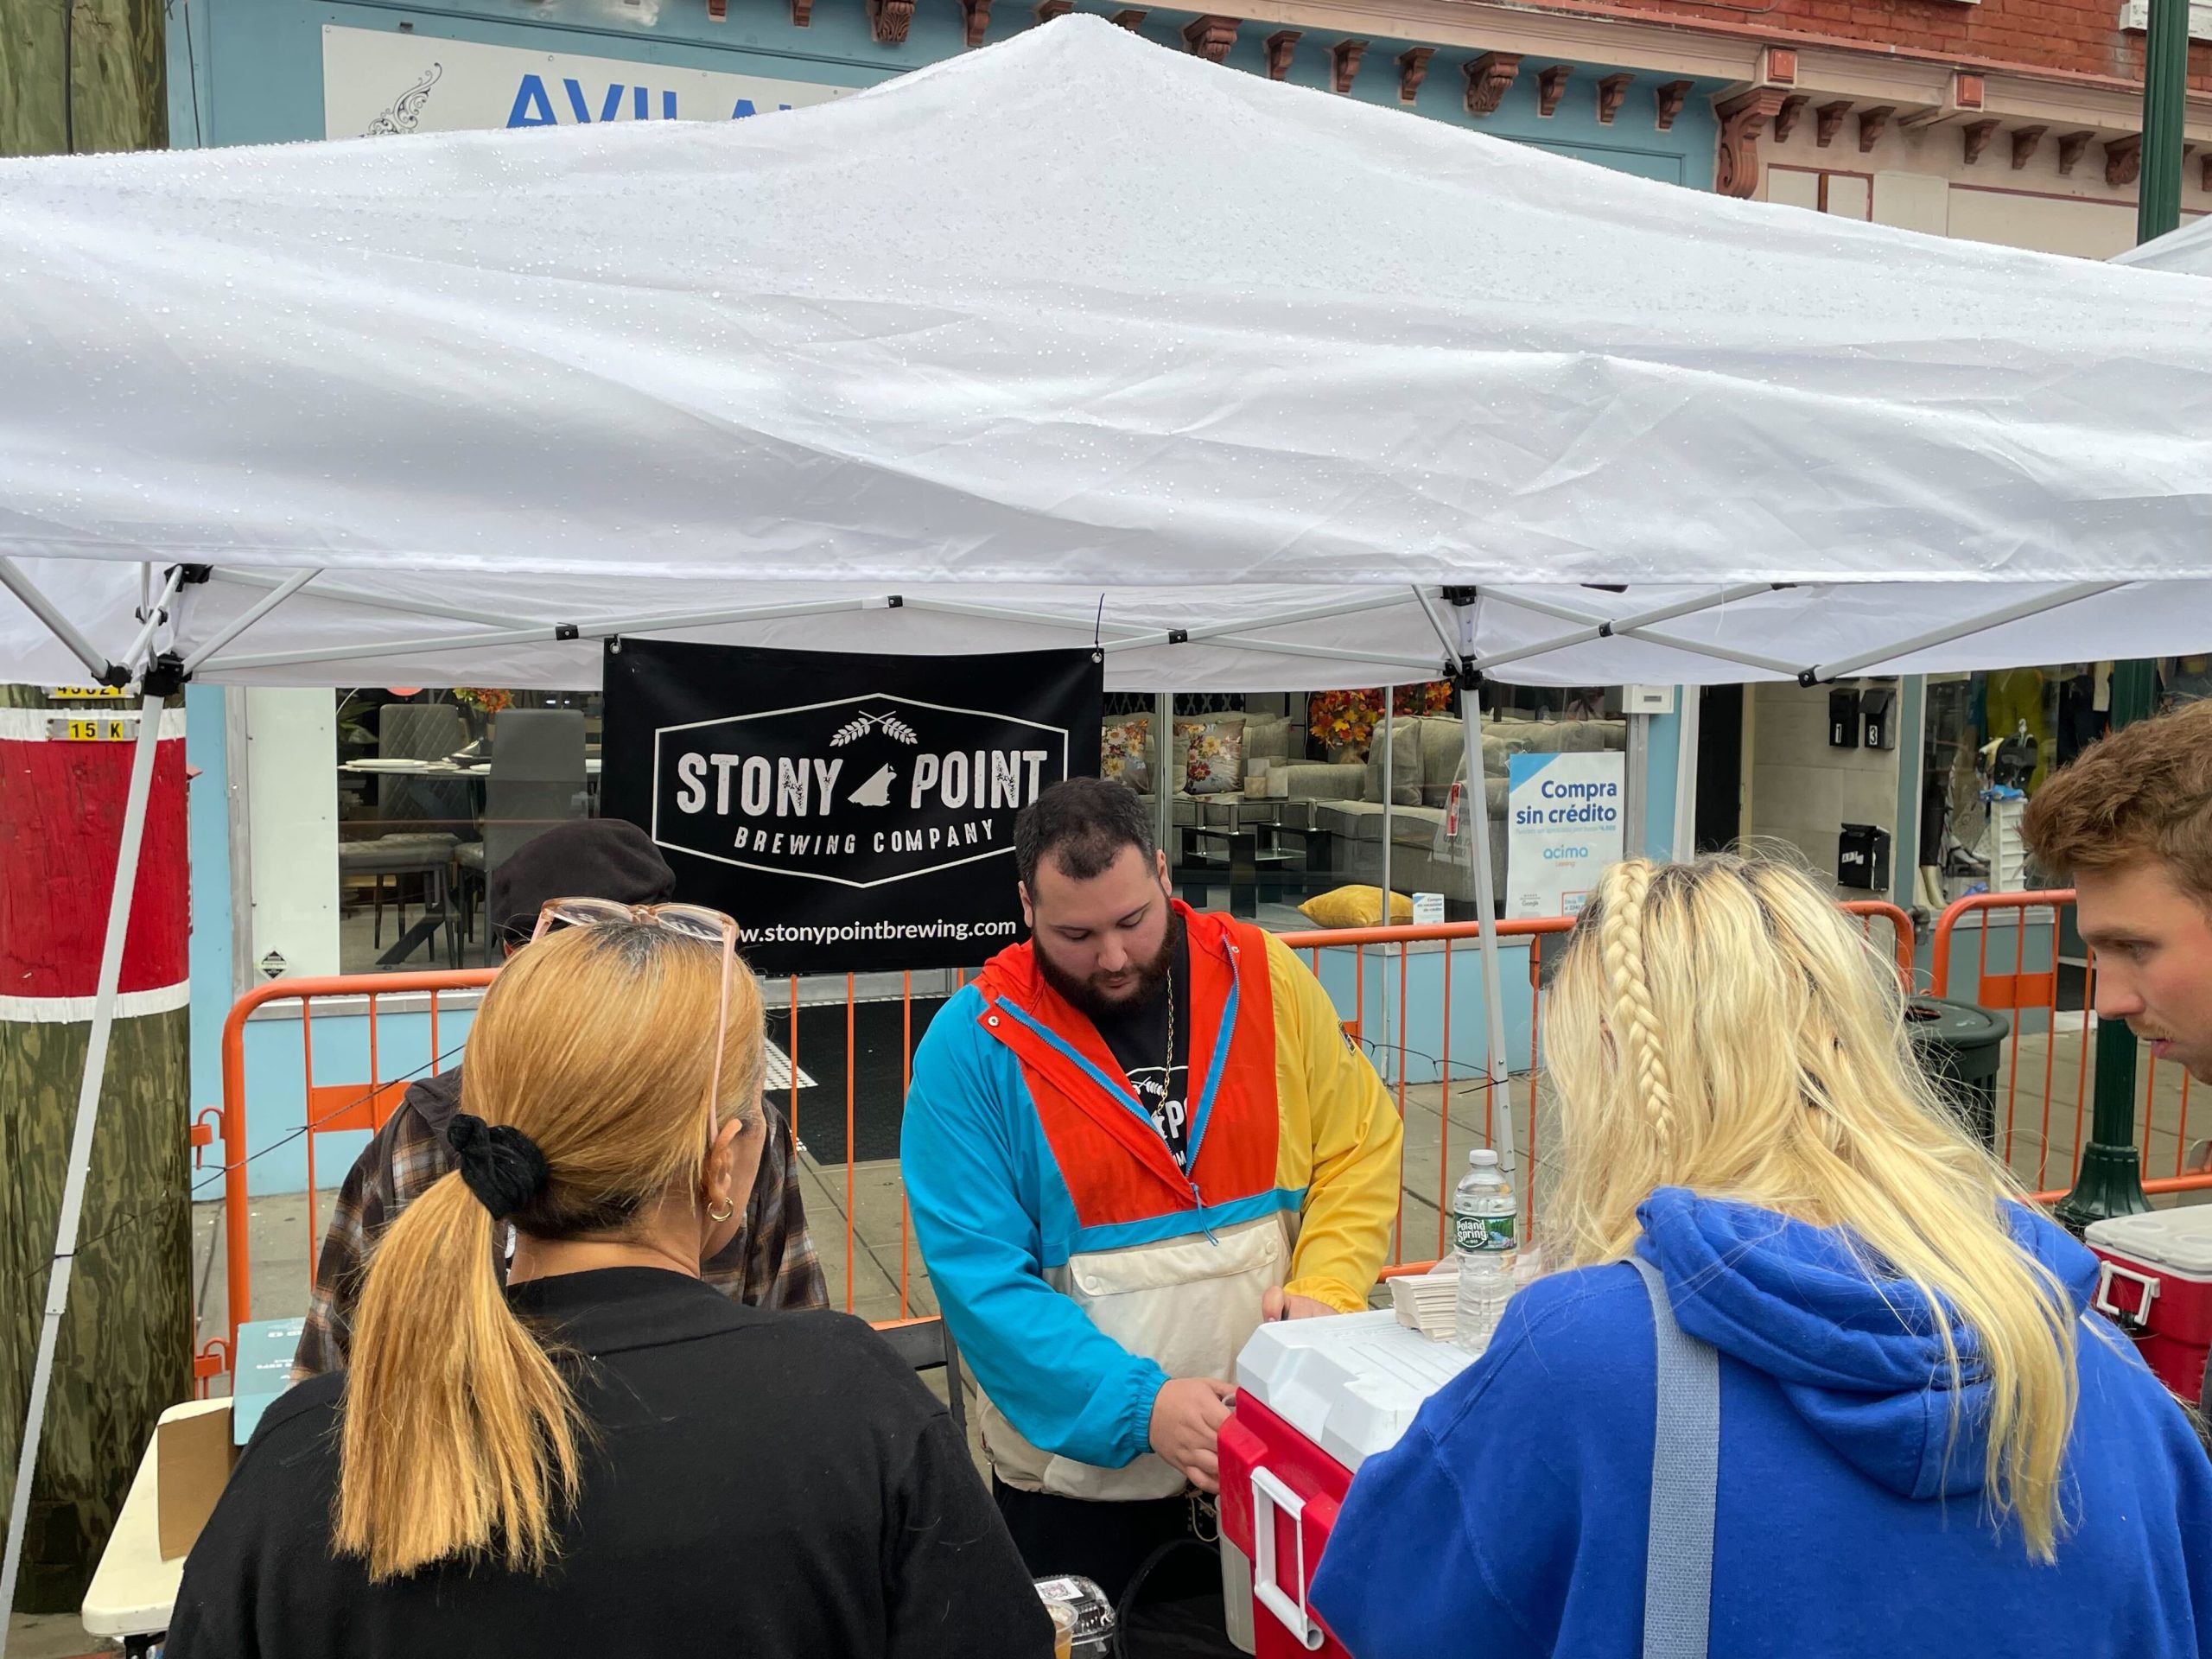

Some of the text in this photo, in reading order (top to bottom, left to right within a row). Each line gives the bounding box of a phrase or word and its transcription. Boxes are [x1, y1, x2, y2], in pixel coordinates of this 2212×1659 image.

[72, 722, 120, 738] 15 K
[677, 750, 1048, 817] STONY POINT
[1541, 780, 1618, 802] Compra
[1516, 804, 1617, 824] sin crédito
[734, 818, 995, 855] BREWING COMPANY
[1543, 844, 1588, 860] acima
[740, 919, 1016, 944] w.stonypointbrewing.com
[1457, 1219, 1485, 1231] Poland
[1458, 1230, 1487, 1243] Spring
